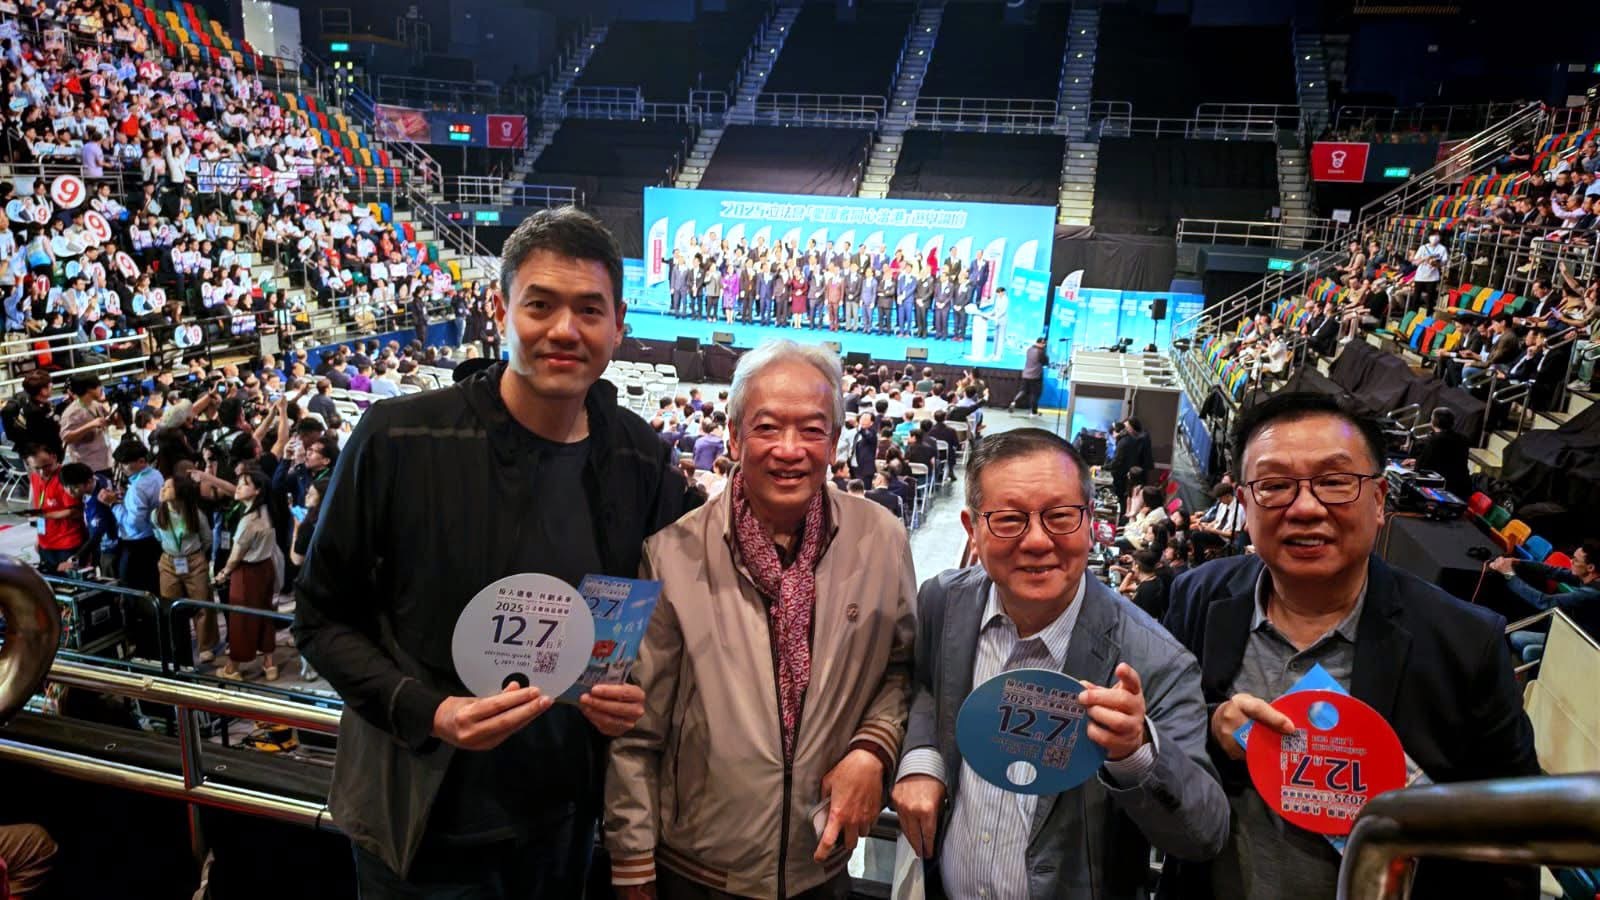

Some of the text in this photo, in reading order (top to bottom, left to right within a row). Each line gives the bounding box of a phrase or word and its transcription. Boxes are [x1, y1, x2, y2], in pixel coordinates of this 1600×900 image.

[57, 179, 80, 204] 9
[38, 208, 48, 222] 9
[88, 214, 107, 239] 9
[119, 255, 136, 277] 9
[495, 601, 524, 613] 2025
[1002, 692, 1033, 706] 2025
[1334, 794, 1366, 806] 2025
